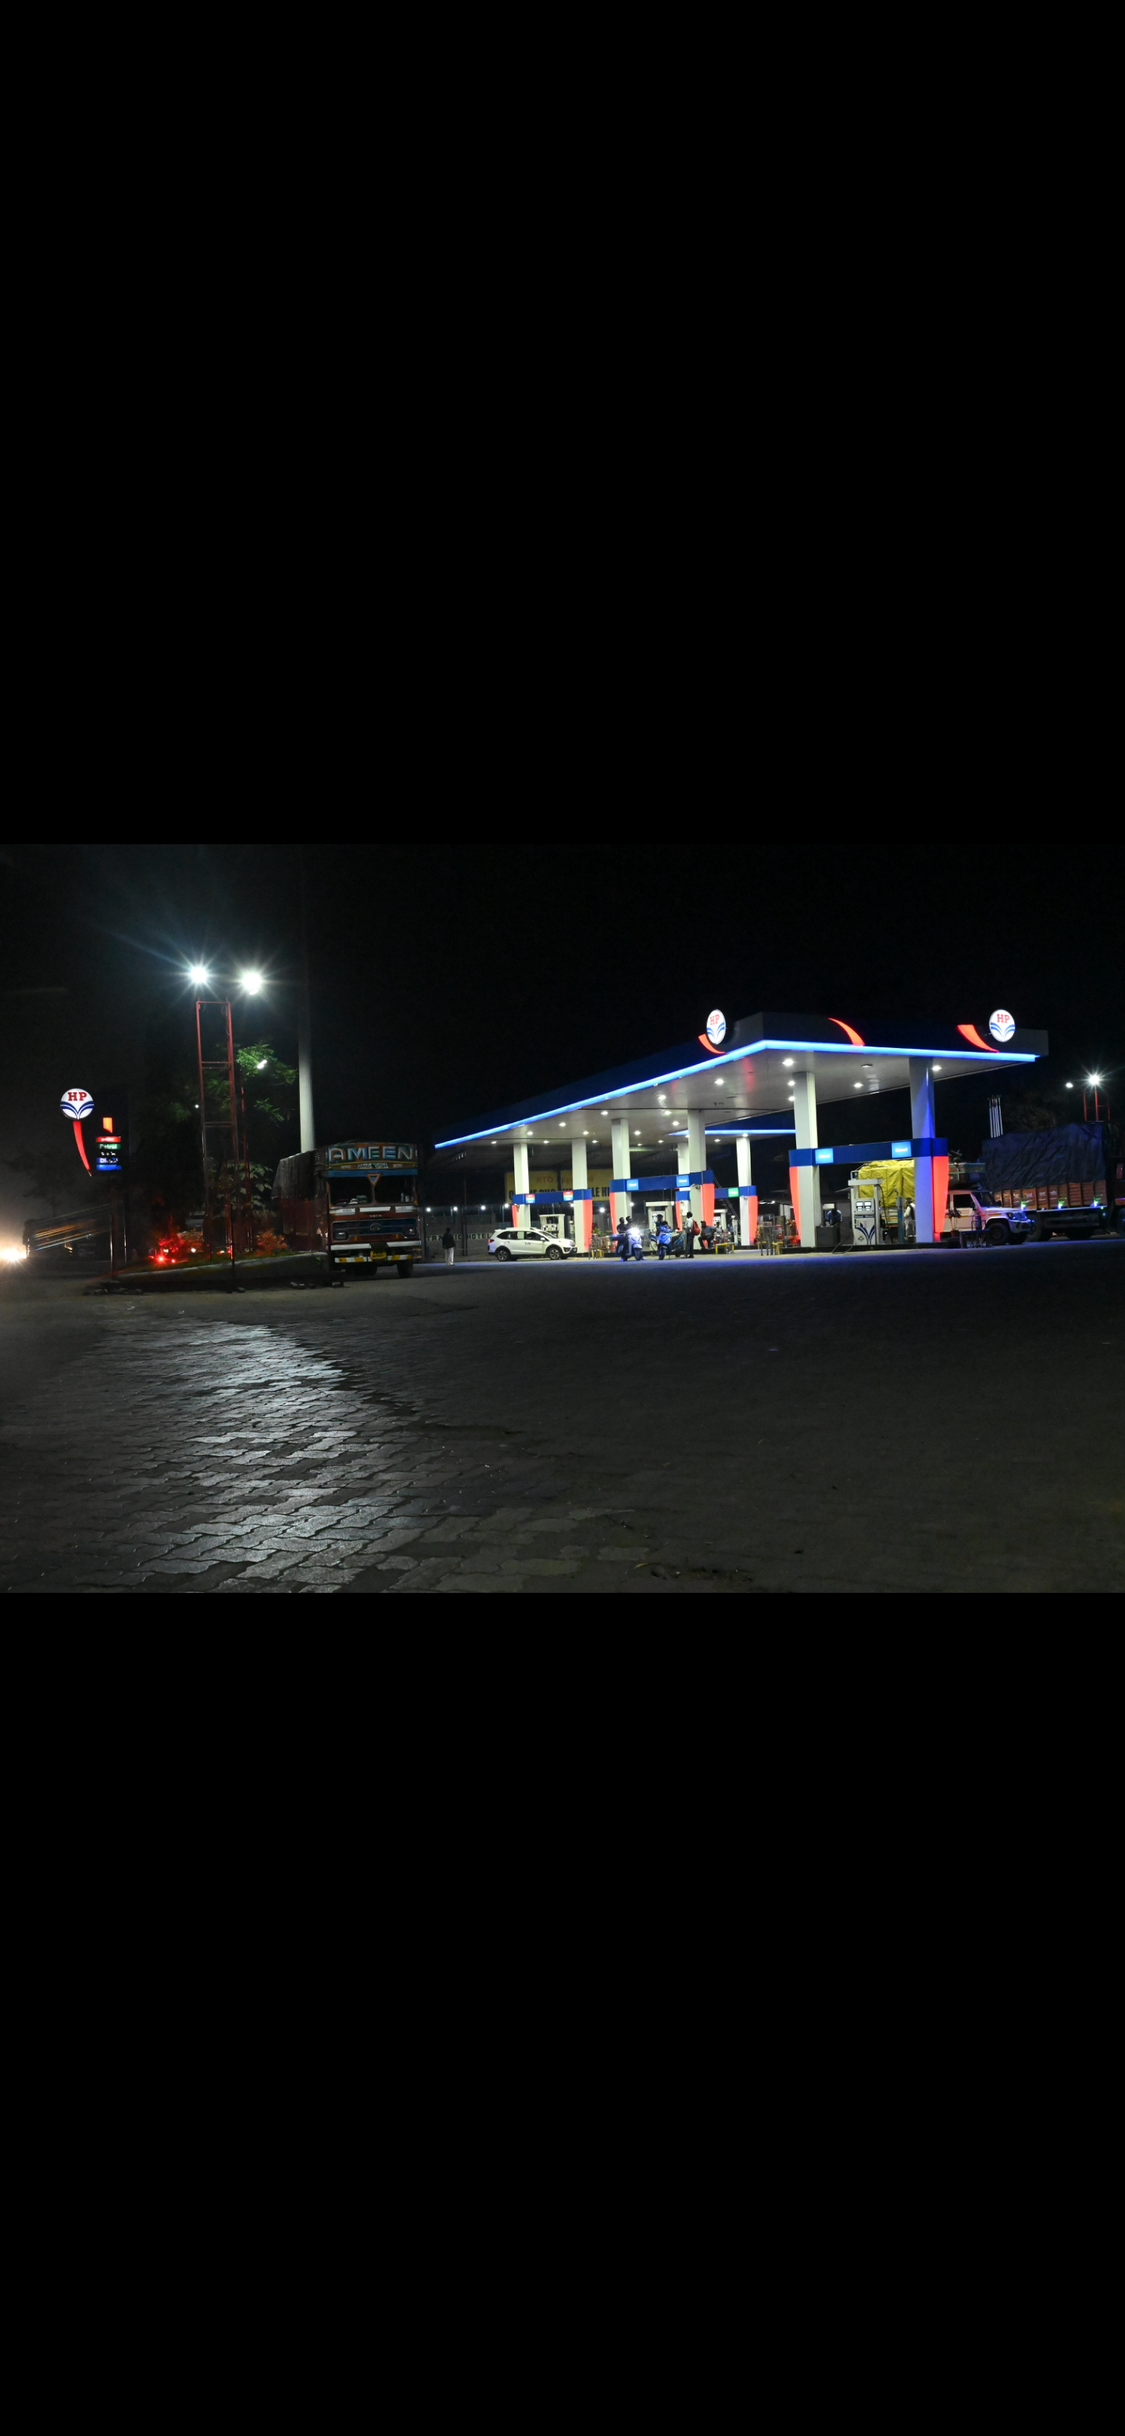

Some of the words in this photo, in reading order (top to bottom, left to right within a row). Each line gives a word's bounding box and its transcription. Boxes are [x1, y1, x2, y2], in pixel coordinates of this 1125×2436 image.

[710, 1014, 720, 1025] HP
[997, 1014, 1010, 1023] HP
[68, 1092, 87, 1101] HP
[328, 1146, 414, 1161] AMEEN
